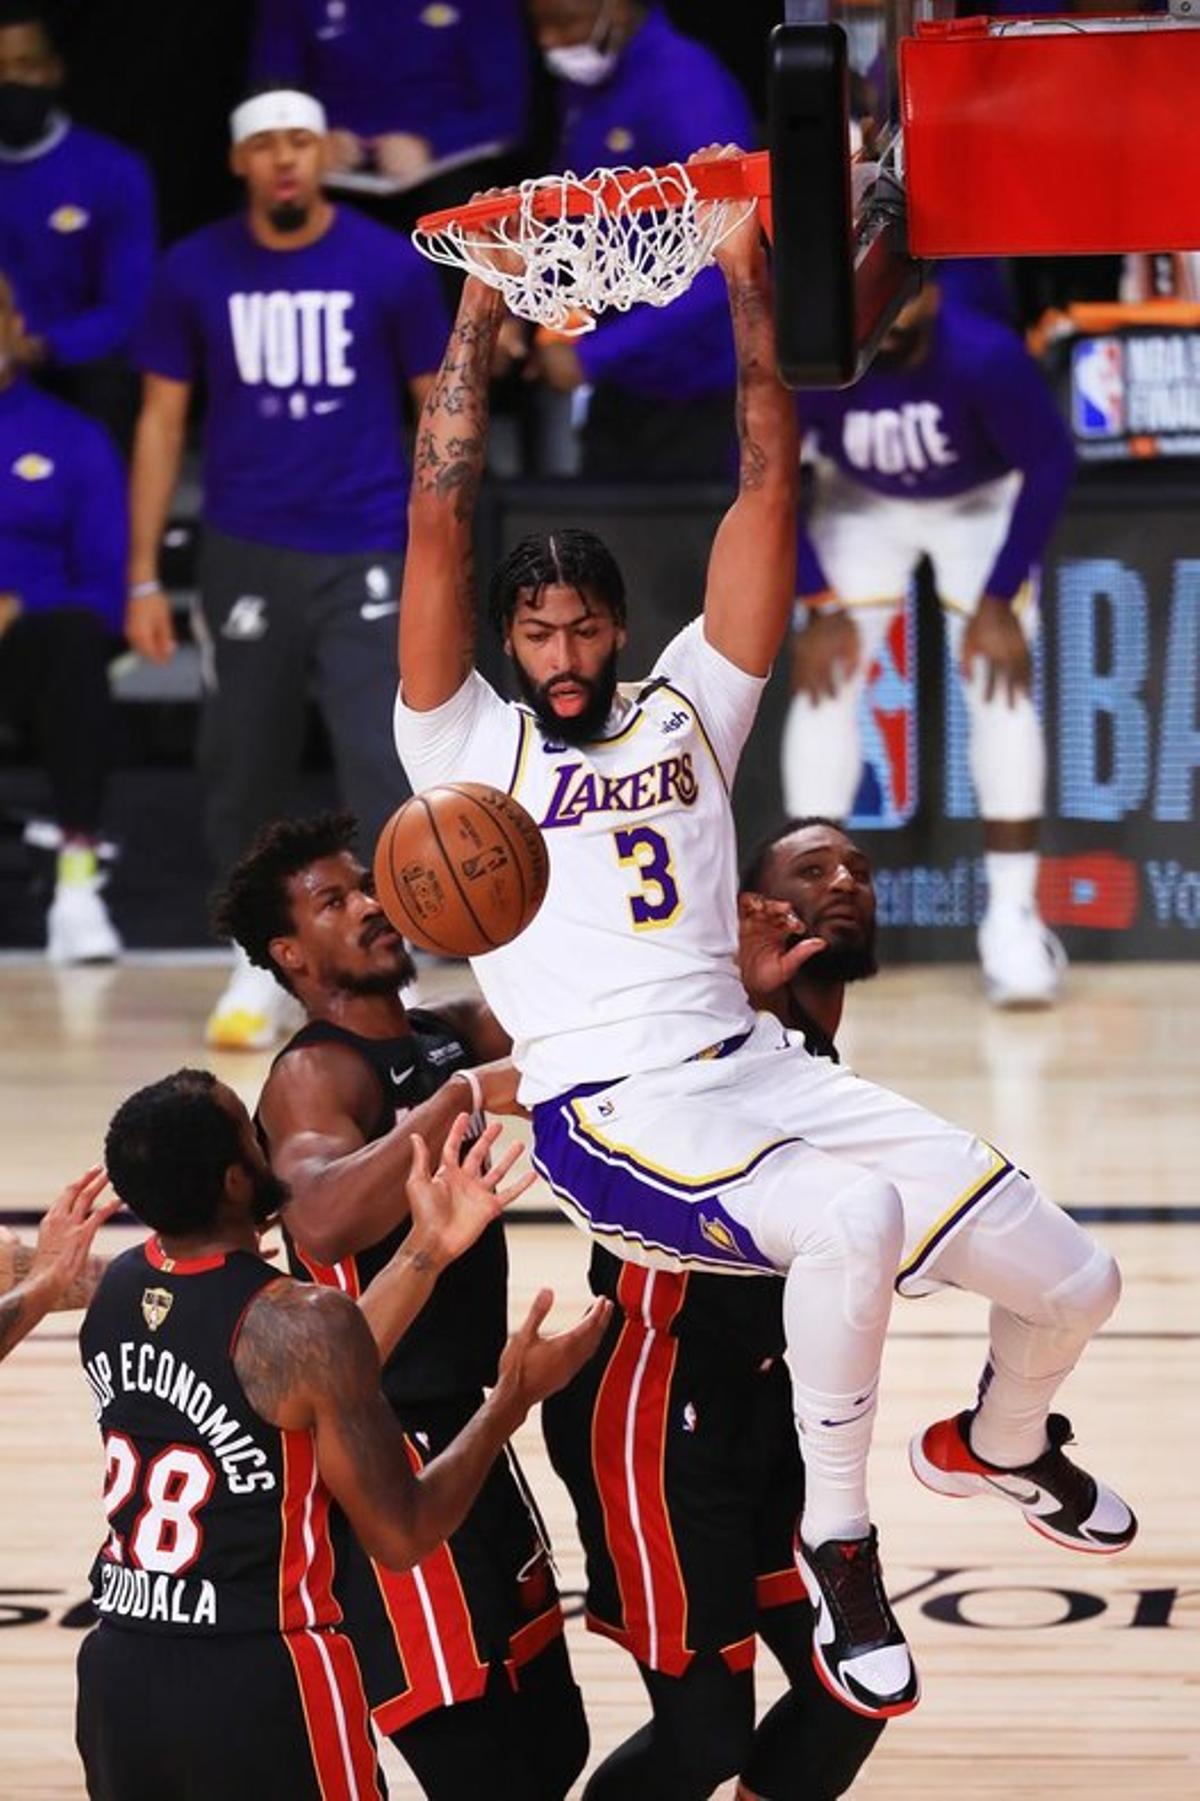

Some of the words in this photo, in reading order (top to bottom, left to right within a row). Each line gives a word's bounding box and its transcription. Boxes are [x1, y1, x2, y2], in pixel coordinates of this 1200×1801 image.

[229, 290, 356, 388] VOTE
[842, 401, 959, 474] VOTE
[660, 710, 690, 735] ish
[539, 752, 698, 829] LAKERS
[612, 822, 685, 933] 3
[119, 1341, 276, 1495] ECONOMICS
[103, 1430, 216, 1575] 28
